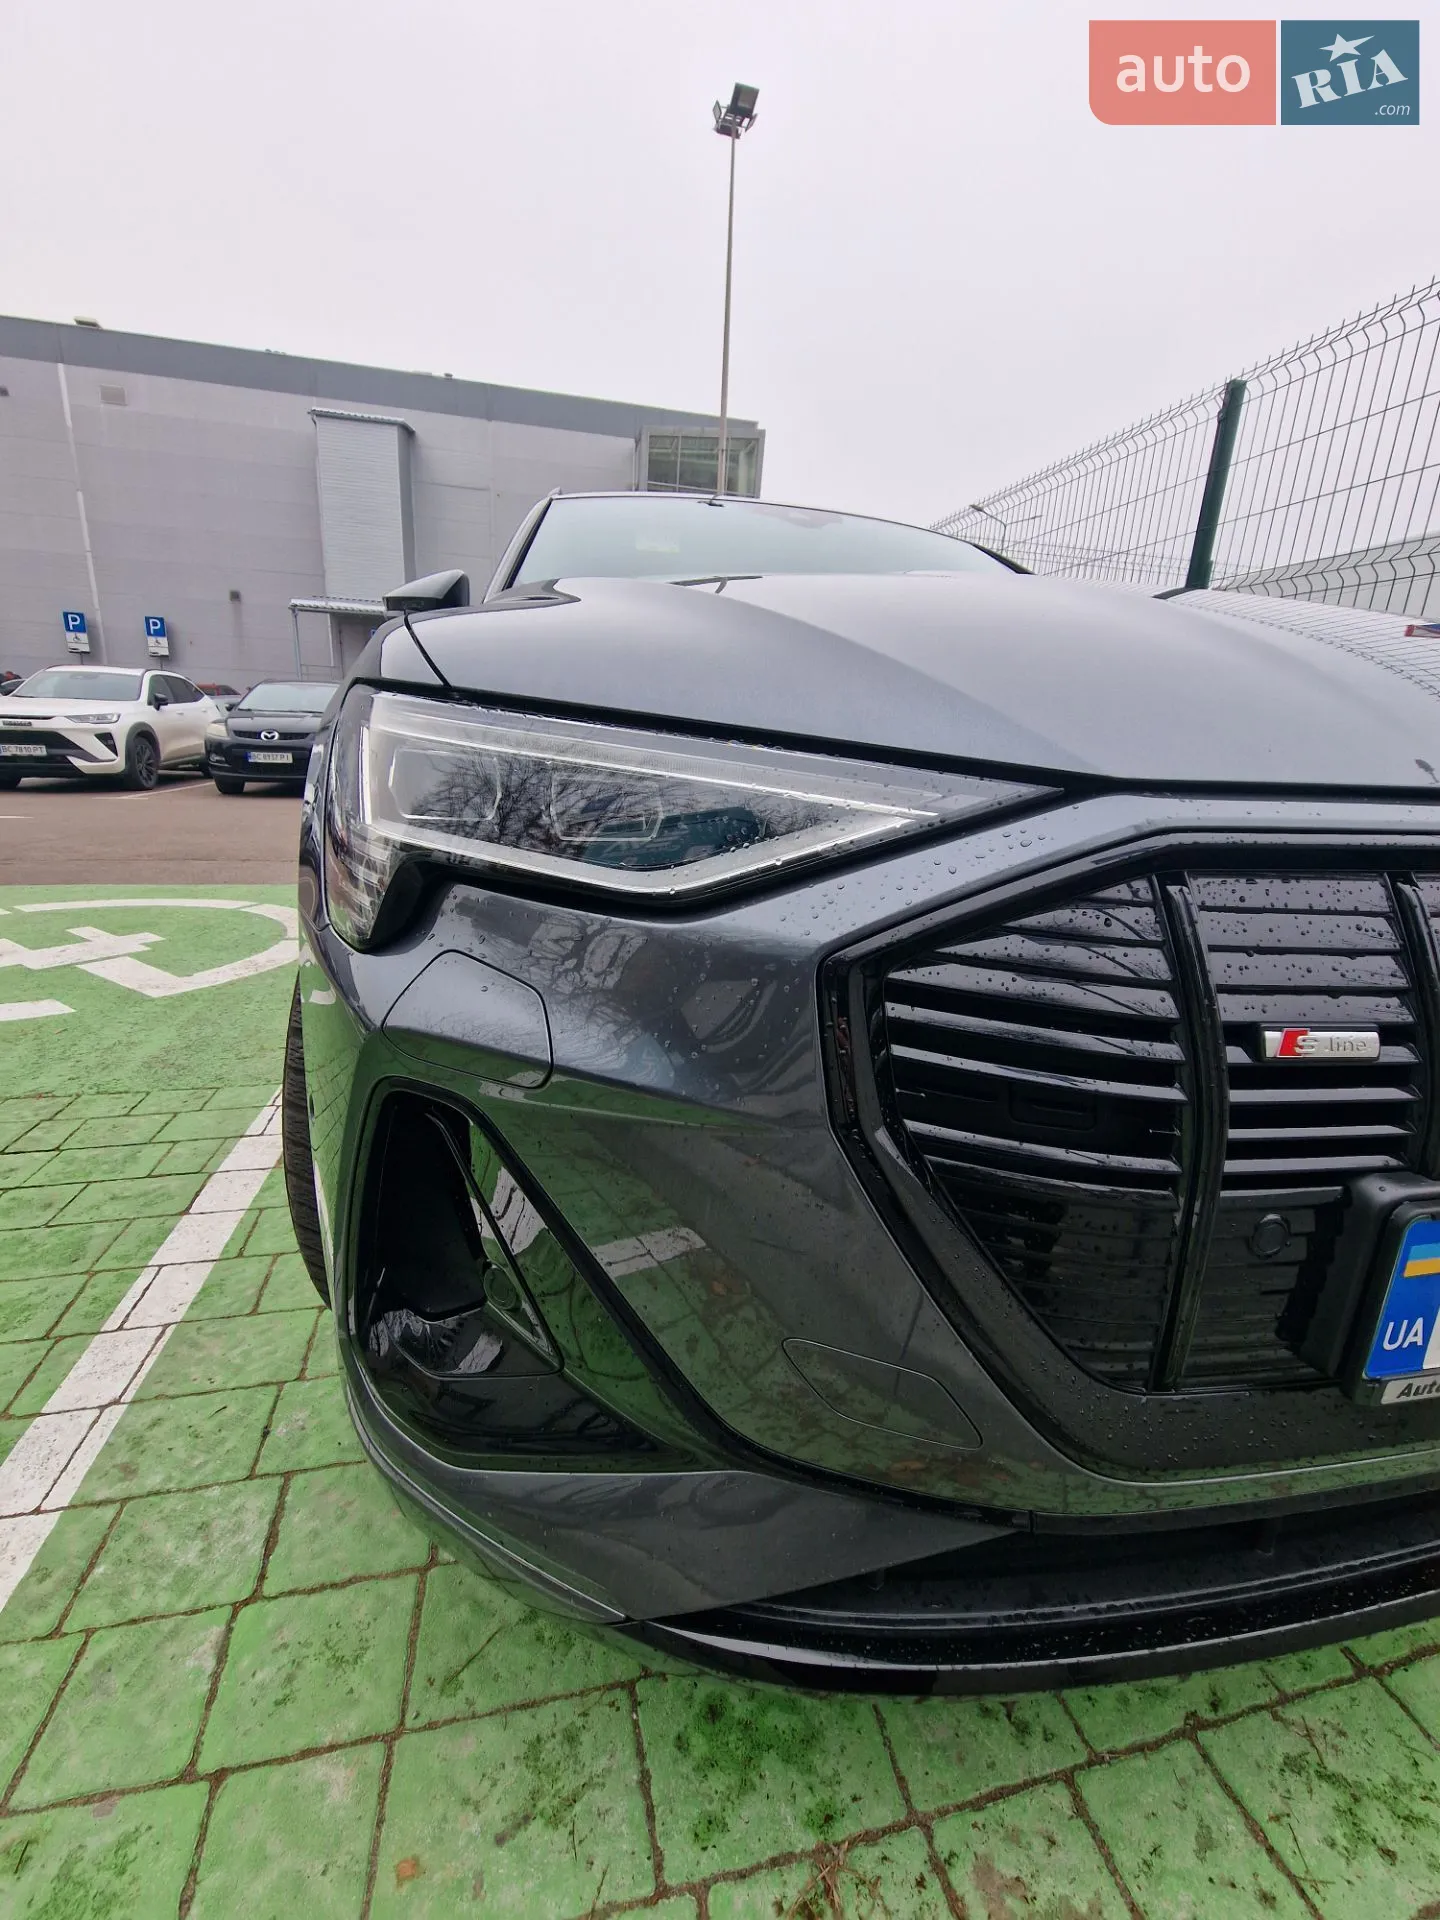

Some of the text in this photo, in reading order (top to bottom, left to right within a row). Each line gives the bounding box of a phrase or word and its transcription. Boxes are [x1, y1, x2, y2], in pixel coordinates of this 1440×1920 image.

[67, 613, 81, 630] P
[149, 618, 161, 635] P
[1329, 1036, 1367, 1052] line
[1382, 1317, 1424, 1350] UA
